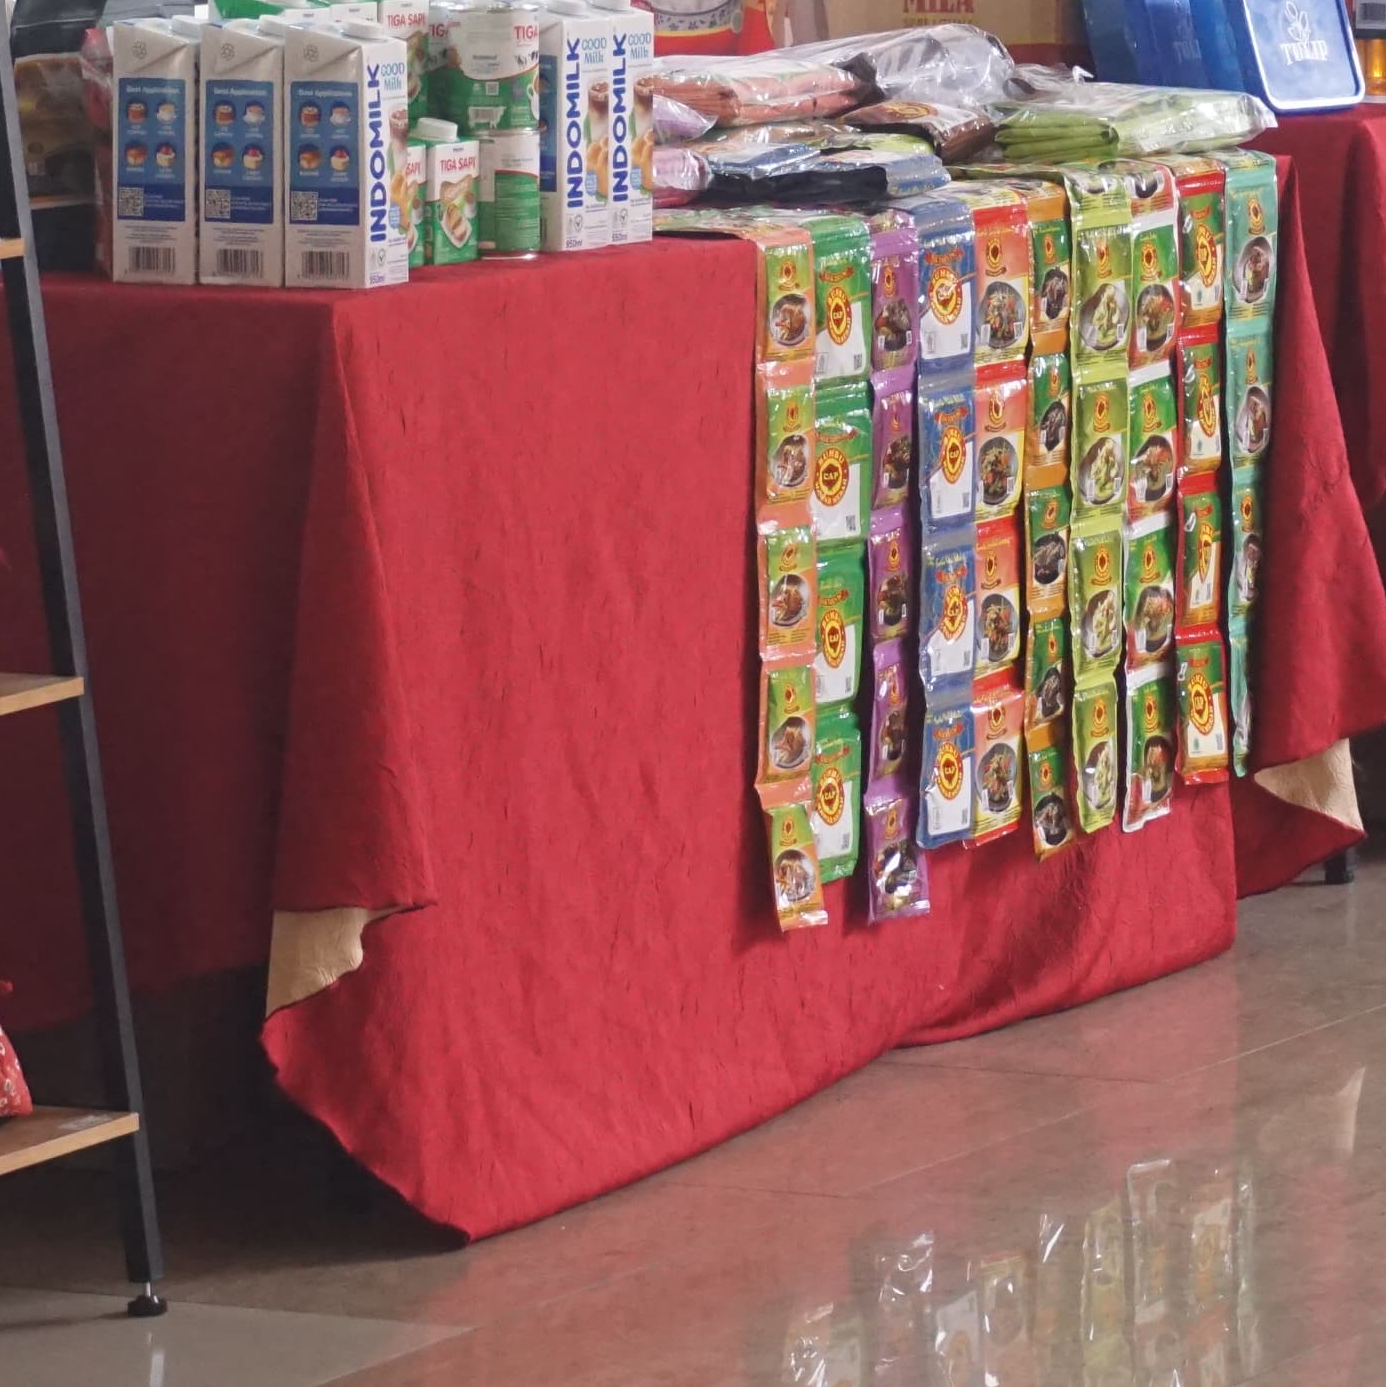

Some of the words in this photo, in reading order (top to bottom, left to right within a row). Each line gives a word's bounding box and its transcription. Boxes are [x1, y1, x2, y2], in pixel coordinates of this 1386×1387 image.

[387, 14, 406, 27] TIGA
[407, 14, 426, 26] SAPI
[514, 25, 539, 40] TIGA
[628, 32, 651, 46] GOOD
[581, 37, 606, 51] GOOD
[584, 52, 604, 65] Milk
[630, 46, 649, 60] Milk
[381, 62, 405, 76] GOOD
[384, 76, 402, 92] Milk
[566, 37, 584, 209] INDOMILK
[613, 33, 629, 203] INDOMILK
[367, 64, 387, 243] INDOMILK
[440, 159, 457, 173] TIGA
[458, 157, 476, 170] SAPI
[823, 473, 839, 481] CAP
